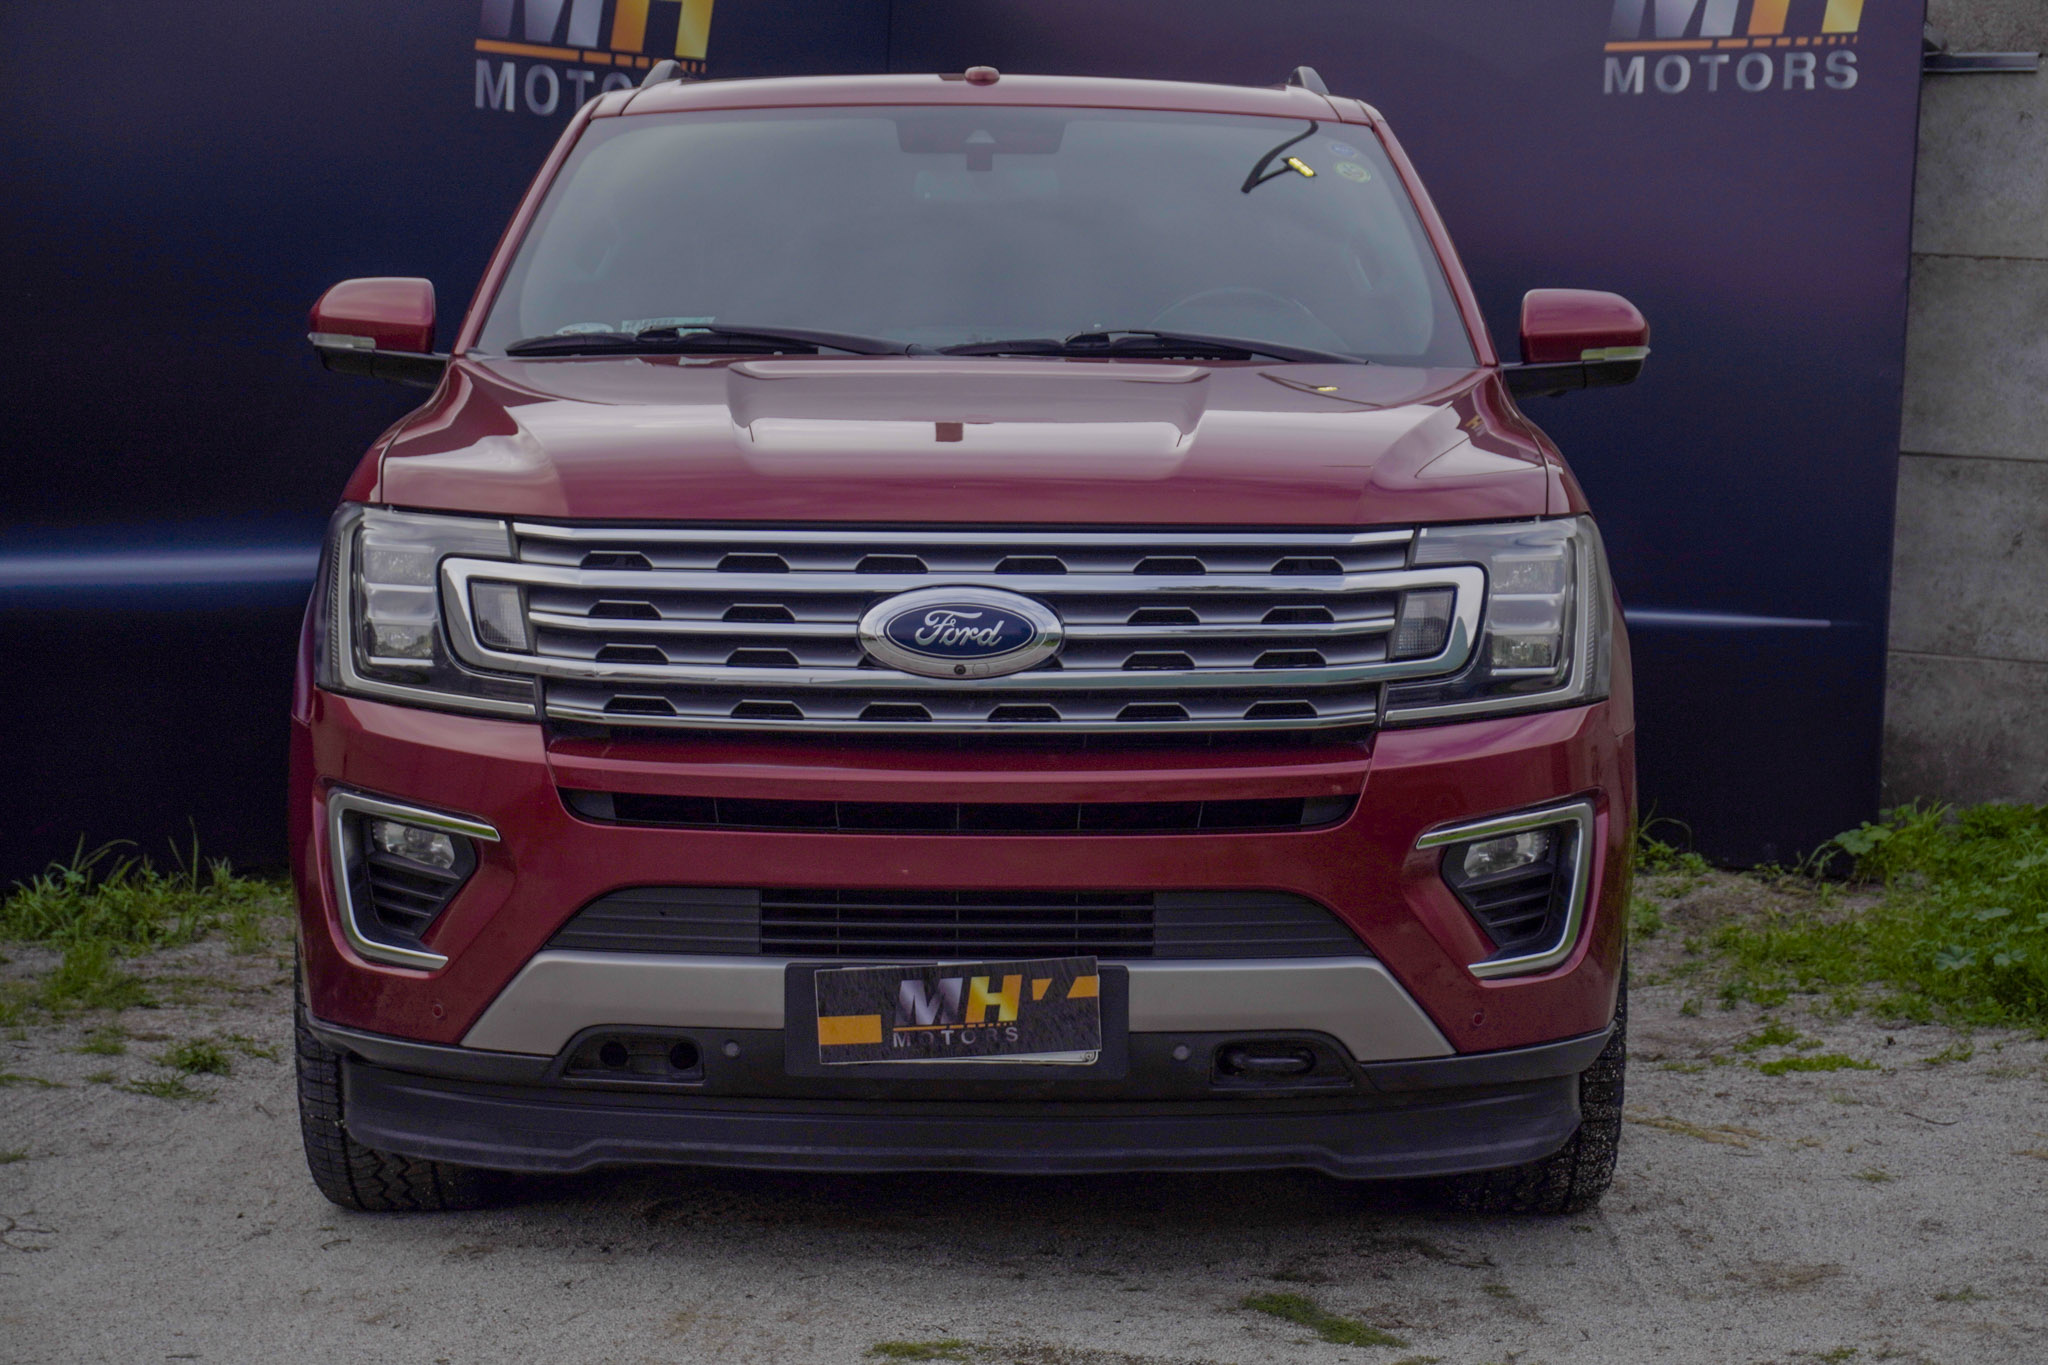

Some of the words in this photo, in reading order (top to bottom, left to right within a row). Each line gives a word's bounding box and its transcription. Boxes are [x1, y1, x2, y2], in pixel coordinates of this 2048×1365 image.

[474, 59, 634, 116] MOT
[1604, 50, 1859, 94] MOTORS
[915, 610, 1005, 646] Ford
[894, 974, 1023, 1025] MH
[893, 1026, 1019, 1048] MOTORS
